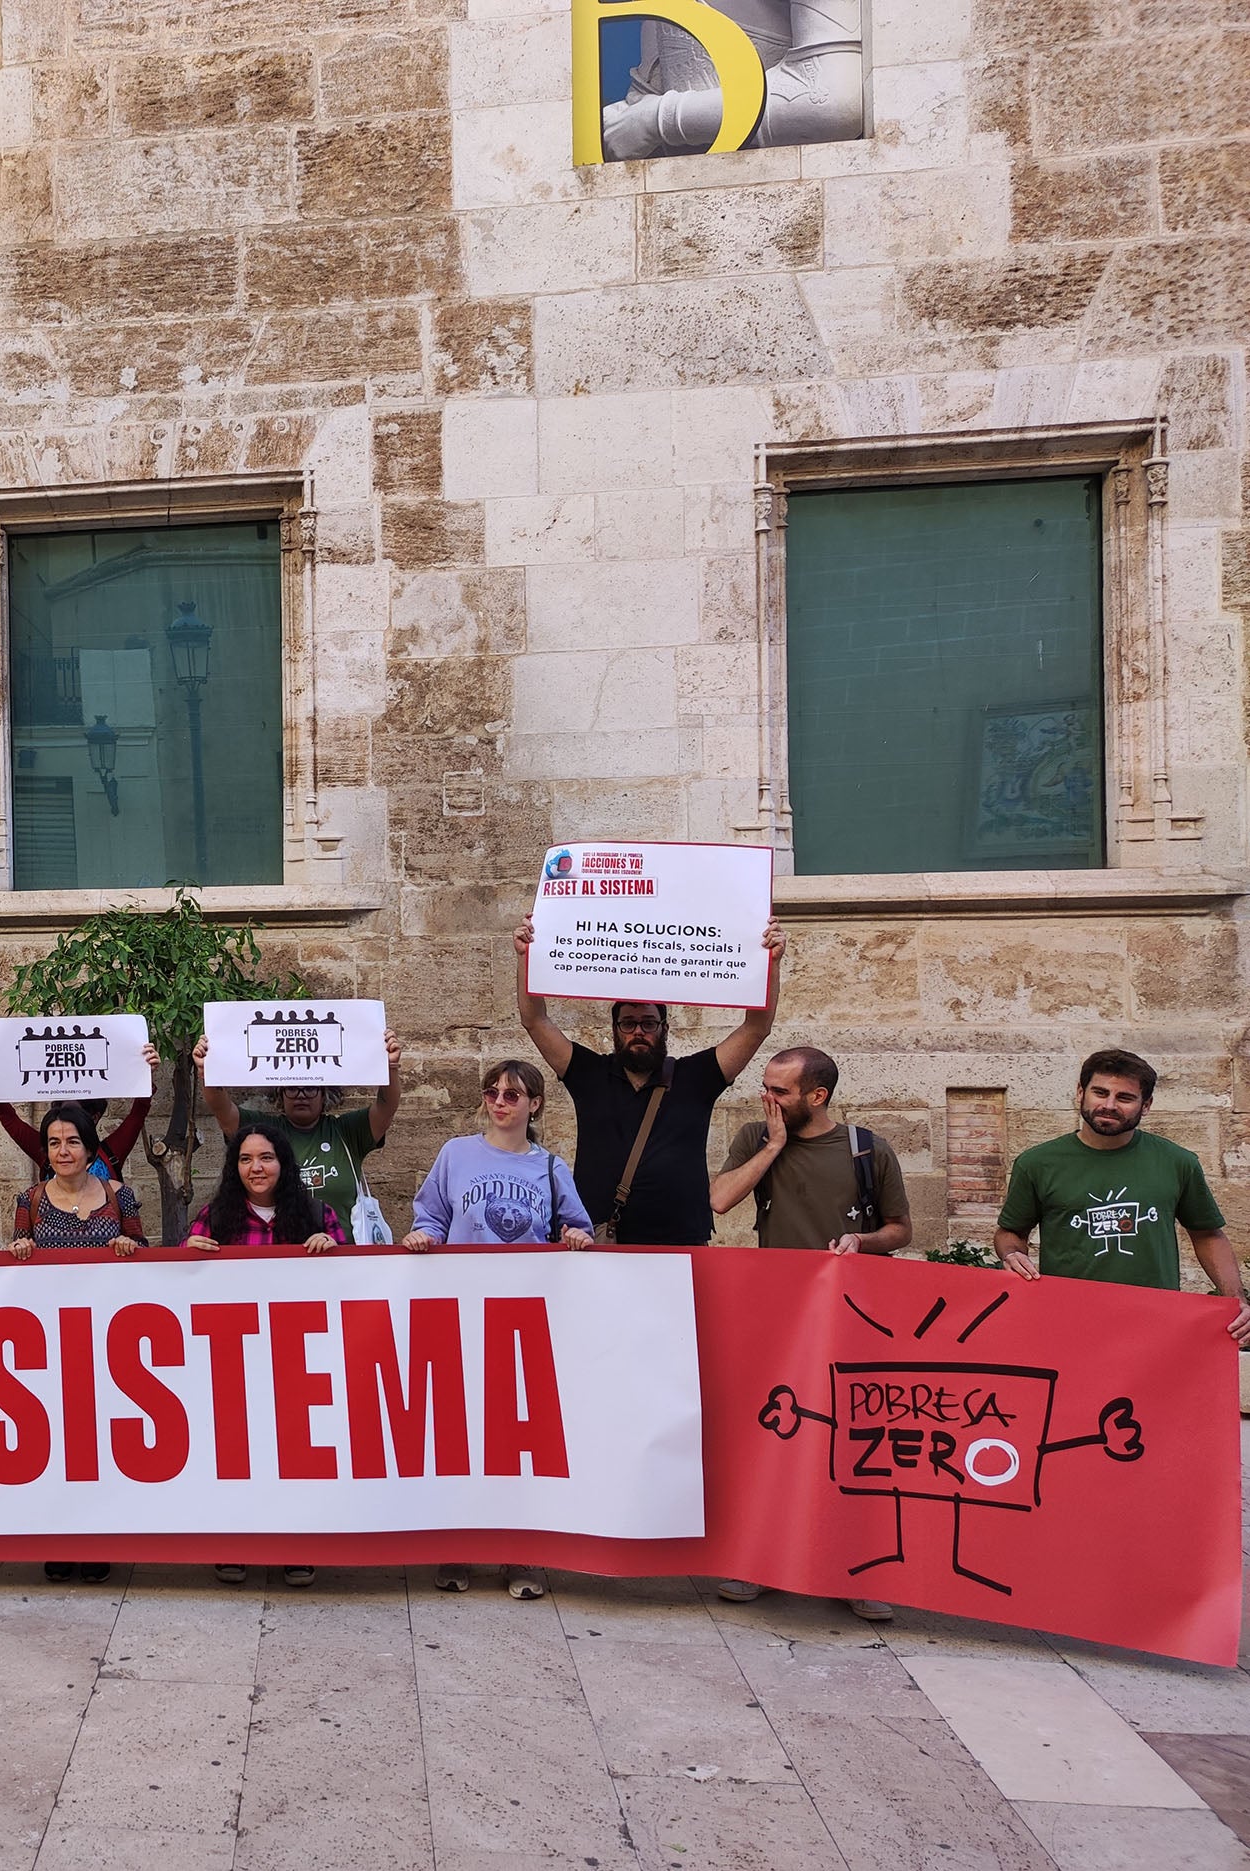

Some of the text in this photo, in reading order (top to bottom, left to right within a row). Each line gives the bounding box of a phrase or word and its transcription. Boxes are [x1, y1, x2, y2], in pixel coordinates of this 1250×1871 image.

[630, 859, 643, 869] YA!
[543, 879, 654, 896] RESET AL SISTEMA
[576, 921, 721, 938] HI HA SOLUCIONS:
[555, 936, 741, 953] les polítiques fiscals, socials i
[549, 949, 746, 968] de cooperació han de garantir que
[554, 964, 573, 972] cap
[576, 965, 617, 973] persona
[620, 966, 658, 975] patisca
[661, 968, 681, 976] fam
[700, 970, 709, 978] el
[713, 971, 740, 980] món.
[275, 1029, 319, 1038] POBRESA
[45, 1044, 85, 1052] POBRESA
[275, 1037, 319, 1053] ZERO
[45, 1052, 86, 1068] ZERO
[469, 1172, 506, 1185] ALWAYS
[462, 1180, 504, 1215] BOLD
[1091, 1209, 1131, 1221] POBRESA
[1093, 1219, 1133, 1235] ZERO
[850, 1382, 1017, 1428] POBRESA
[849, 1426, 1020, 1487] ZERO
